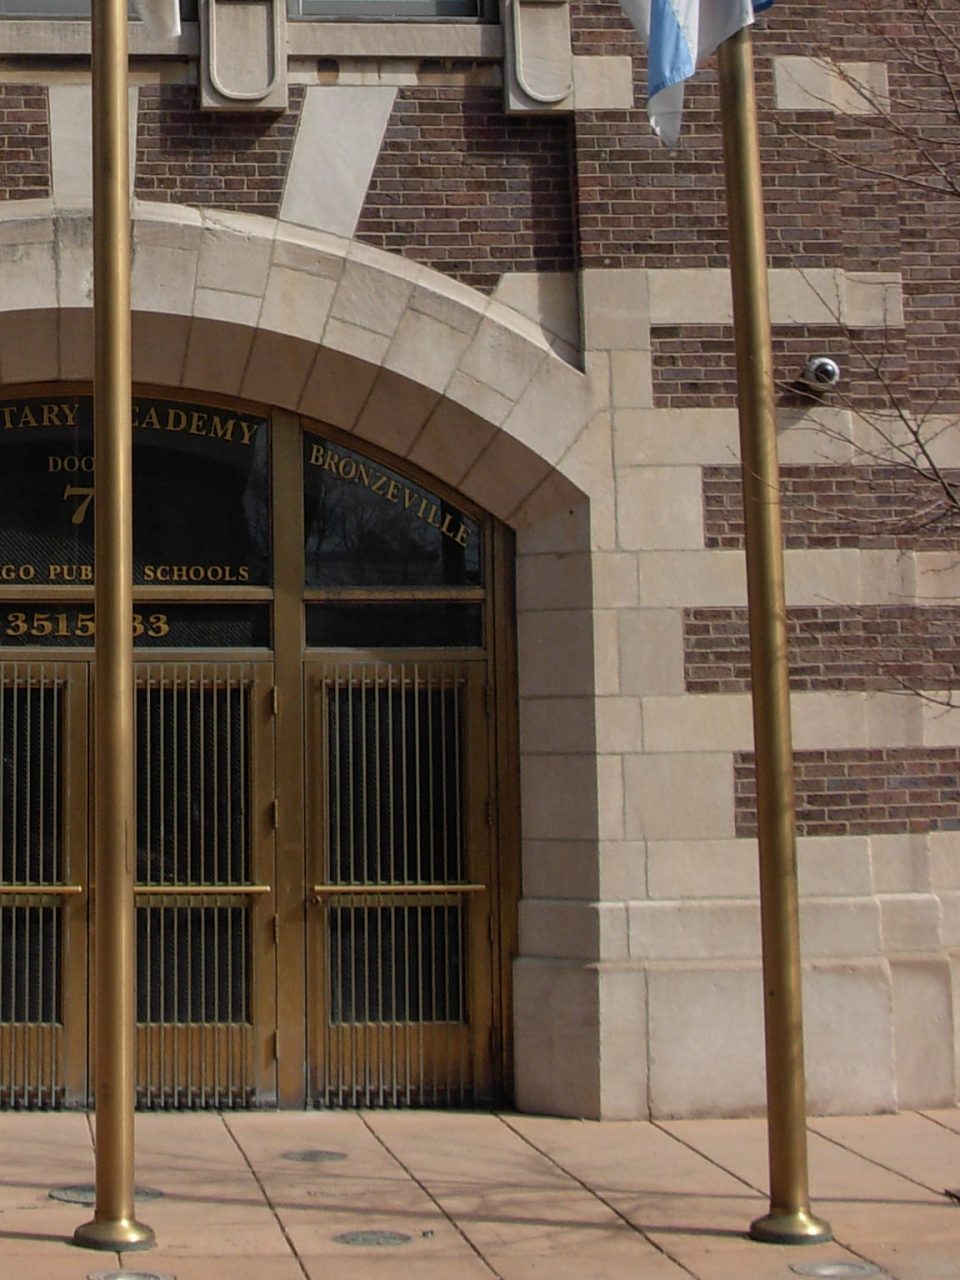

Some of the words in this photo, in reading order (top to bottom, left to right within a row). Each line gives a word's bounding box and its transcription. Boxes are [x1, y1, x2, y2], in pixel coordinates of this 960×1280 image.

[48, 455, 96, 473] DOO
[132, 405, 259, 446] ADEMY
[309, 443, 472, 547] BRONZEVILLE
[63, 484, 96, 525] 7
[48, 564, 94, 581] PUB
[143, 564, 250, 582] SCHOOLS
